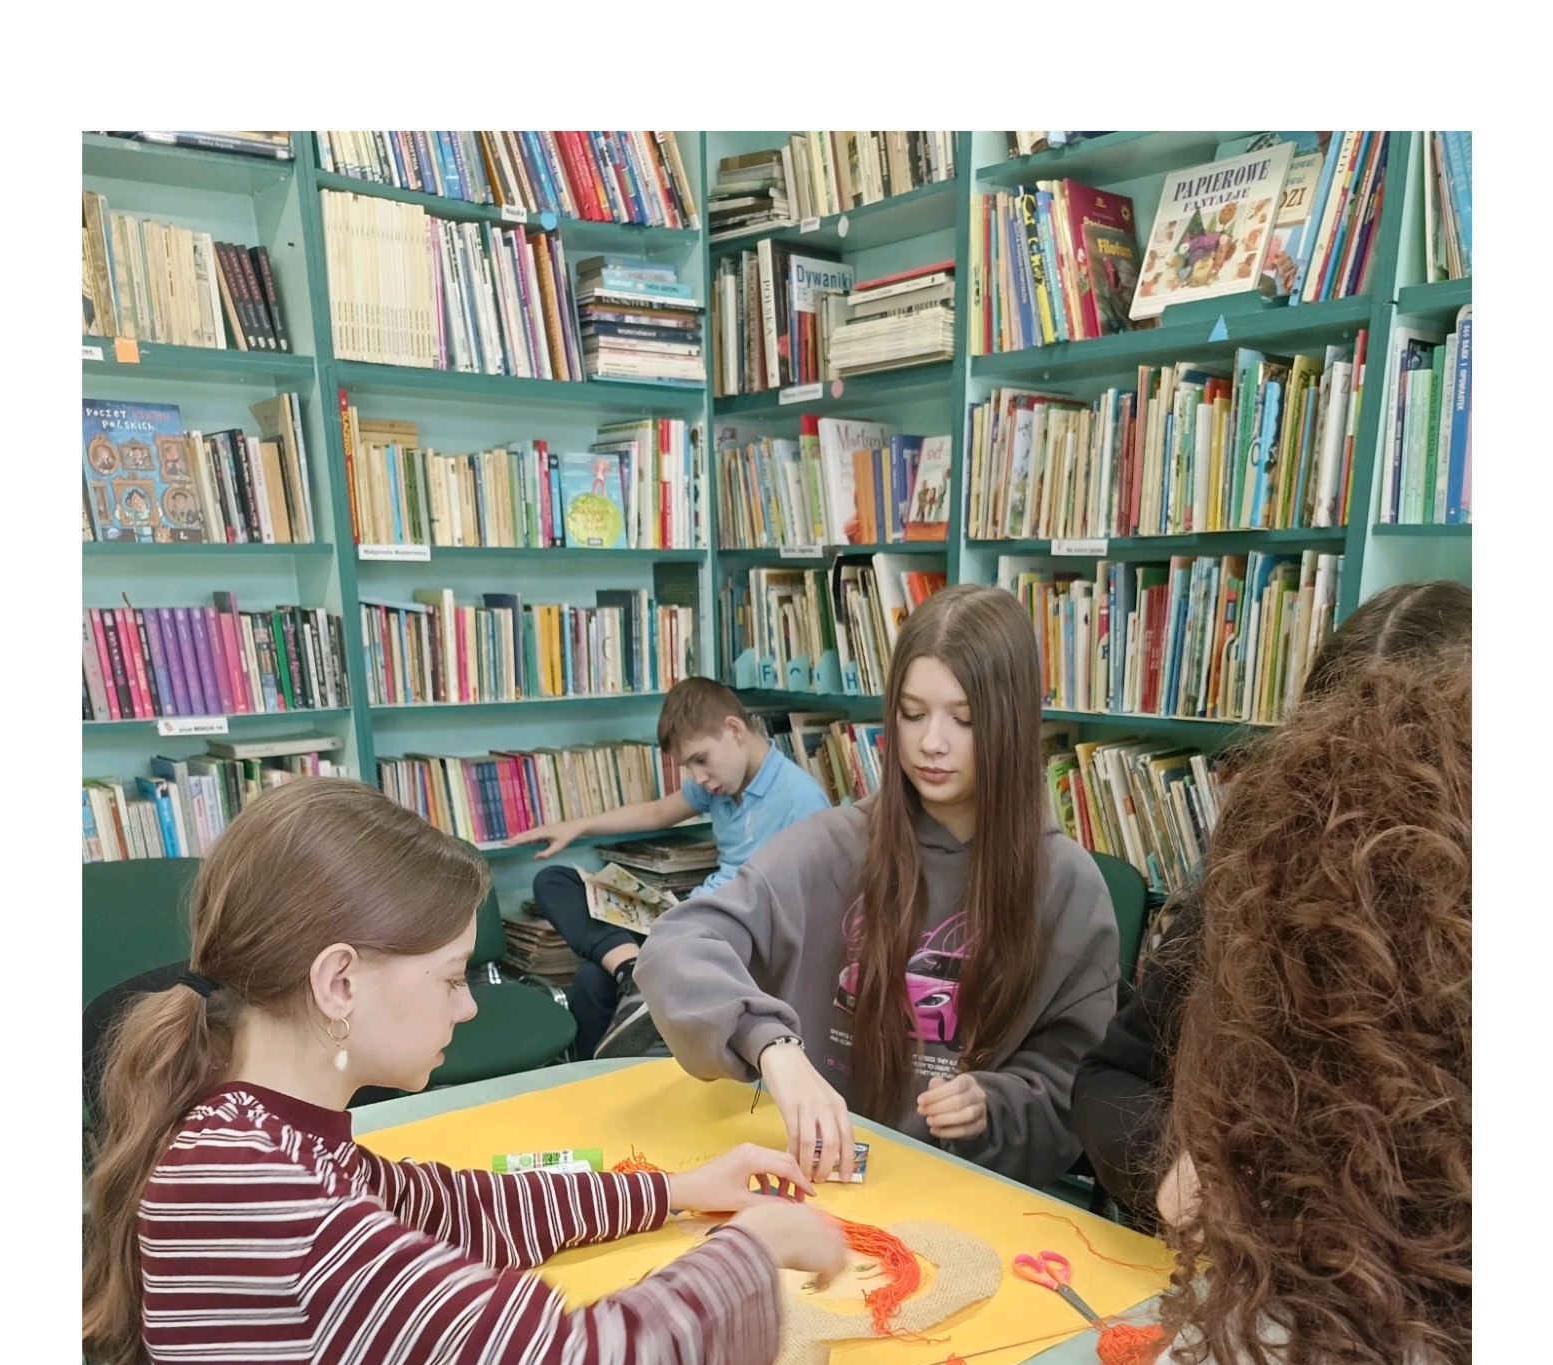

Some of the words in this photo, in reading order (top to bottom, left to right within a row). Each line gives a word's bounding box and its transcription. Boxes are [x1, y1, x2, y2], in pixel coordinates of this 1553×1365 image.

[1172, 158, 1272, 202] PAPIEROWE
[1183, 187, 1251, 213] FANTAZJE
[796, 264, 853, 290] Dywaniki
[762, 280, 774, 336] POLSKA
[341, 410, 352, 457] DLACZEGO
[763, 663, 772, 682] F
